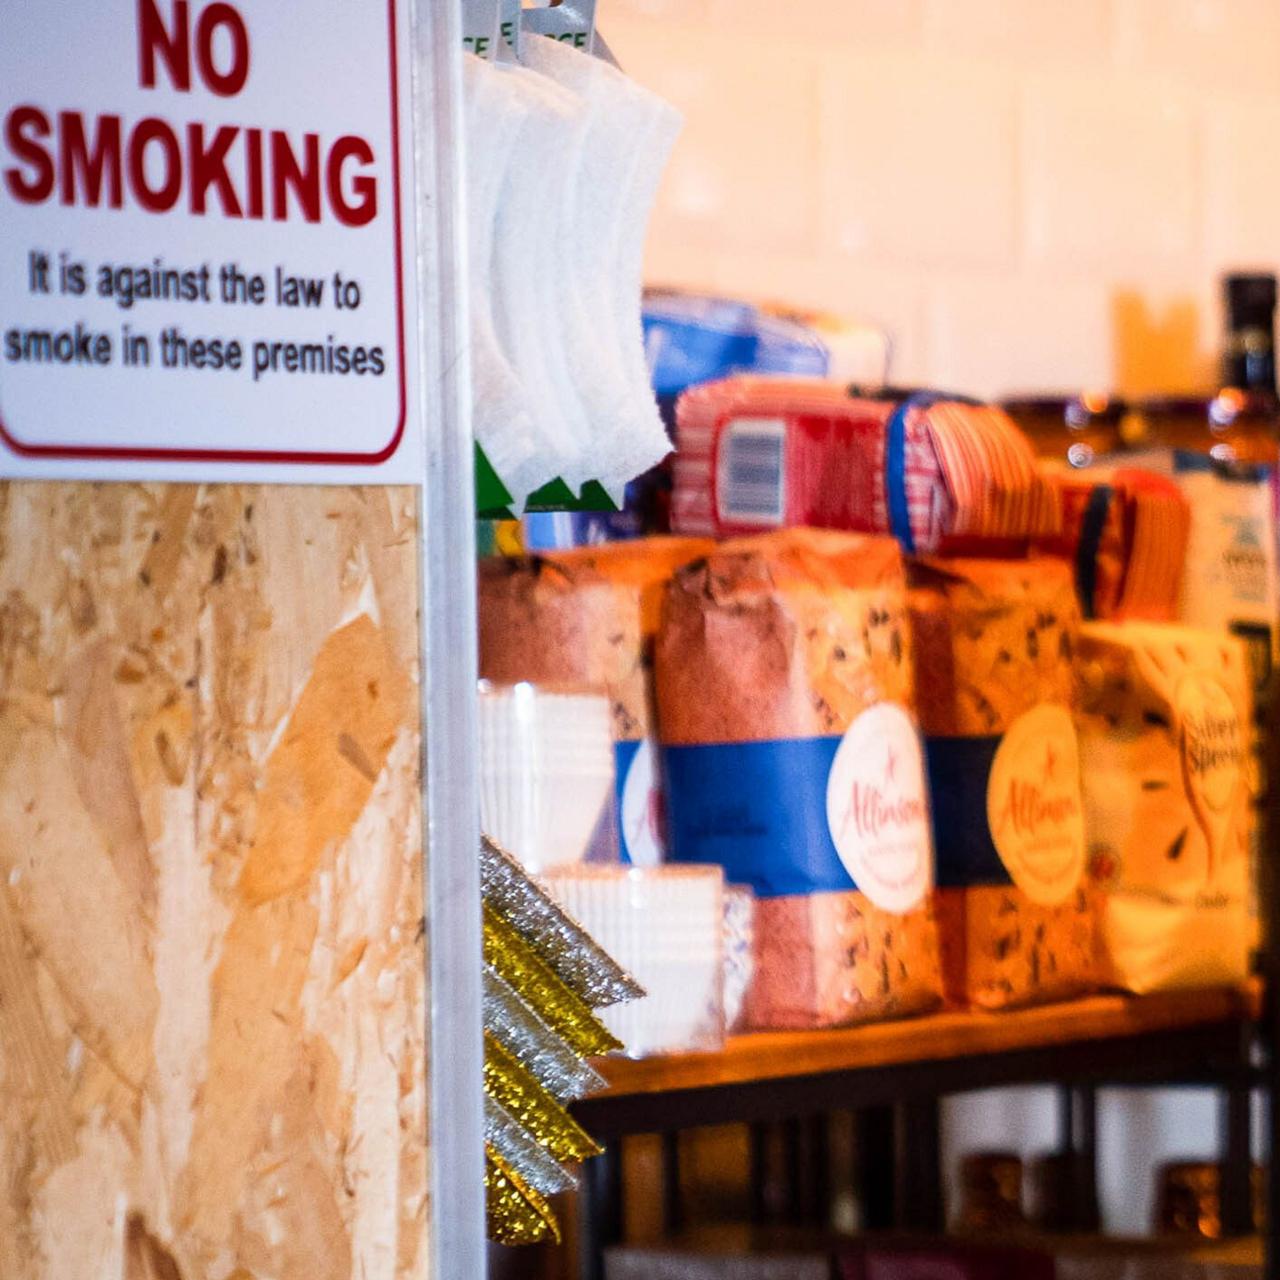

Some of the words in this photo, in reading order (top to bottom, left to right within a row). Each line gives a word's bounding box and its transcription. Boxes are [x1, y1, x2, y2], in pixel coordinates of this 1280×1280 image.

[135, 0, 249, 97] NO
[4, 105, 378, 228] SMOKING
[29, 250, 50, 293] It
[59, 250, 87, 296] is
[97, 258, 211, 308] against
[218, 264, 266, 305] the
[275, 266, 325, 307] law
[332, 272, 362, 310] to
[4, 323, 112, 366] smoke
[121, 324, 151, 367] in
[160, 327, 243, 370] these
[254, 334, 386, 381] premises
